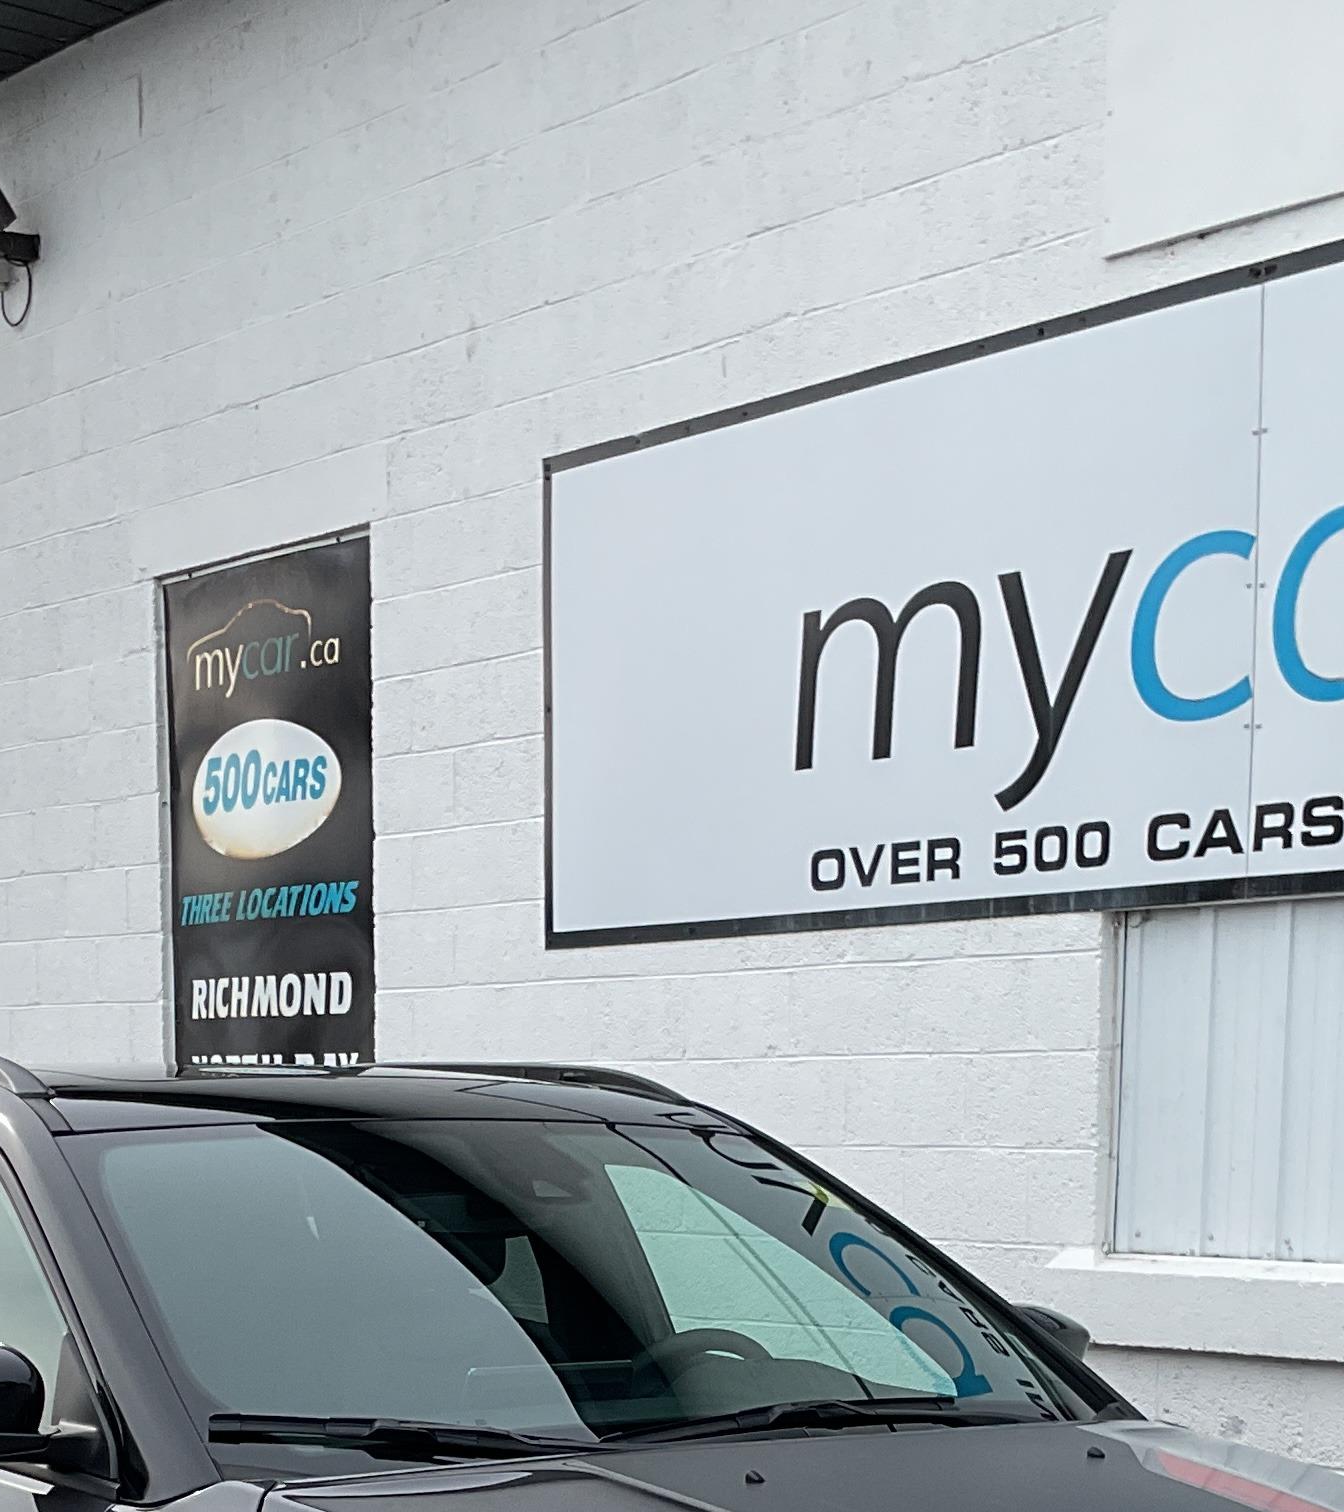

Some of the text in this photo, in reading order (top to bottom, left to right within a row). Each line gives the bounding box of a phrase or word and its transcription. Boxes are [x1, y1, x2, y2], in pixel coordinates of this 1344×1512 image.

[194, 631, 340, 698] mycar.ca
[810, 836, 961, 892] OVER
[992, 820, 1112, 876] 500
[1146, 795, 1344, 862] CARS
[180, 880, 360, 926] THREE LOCATIONS
[191, 971, 353, 1020] RICHMOND
